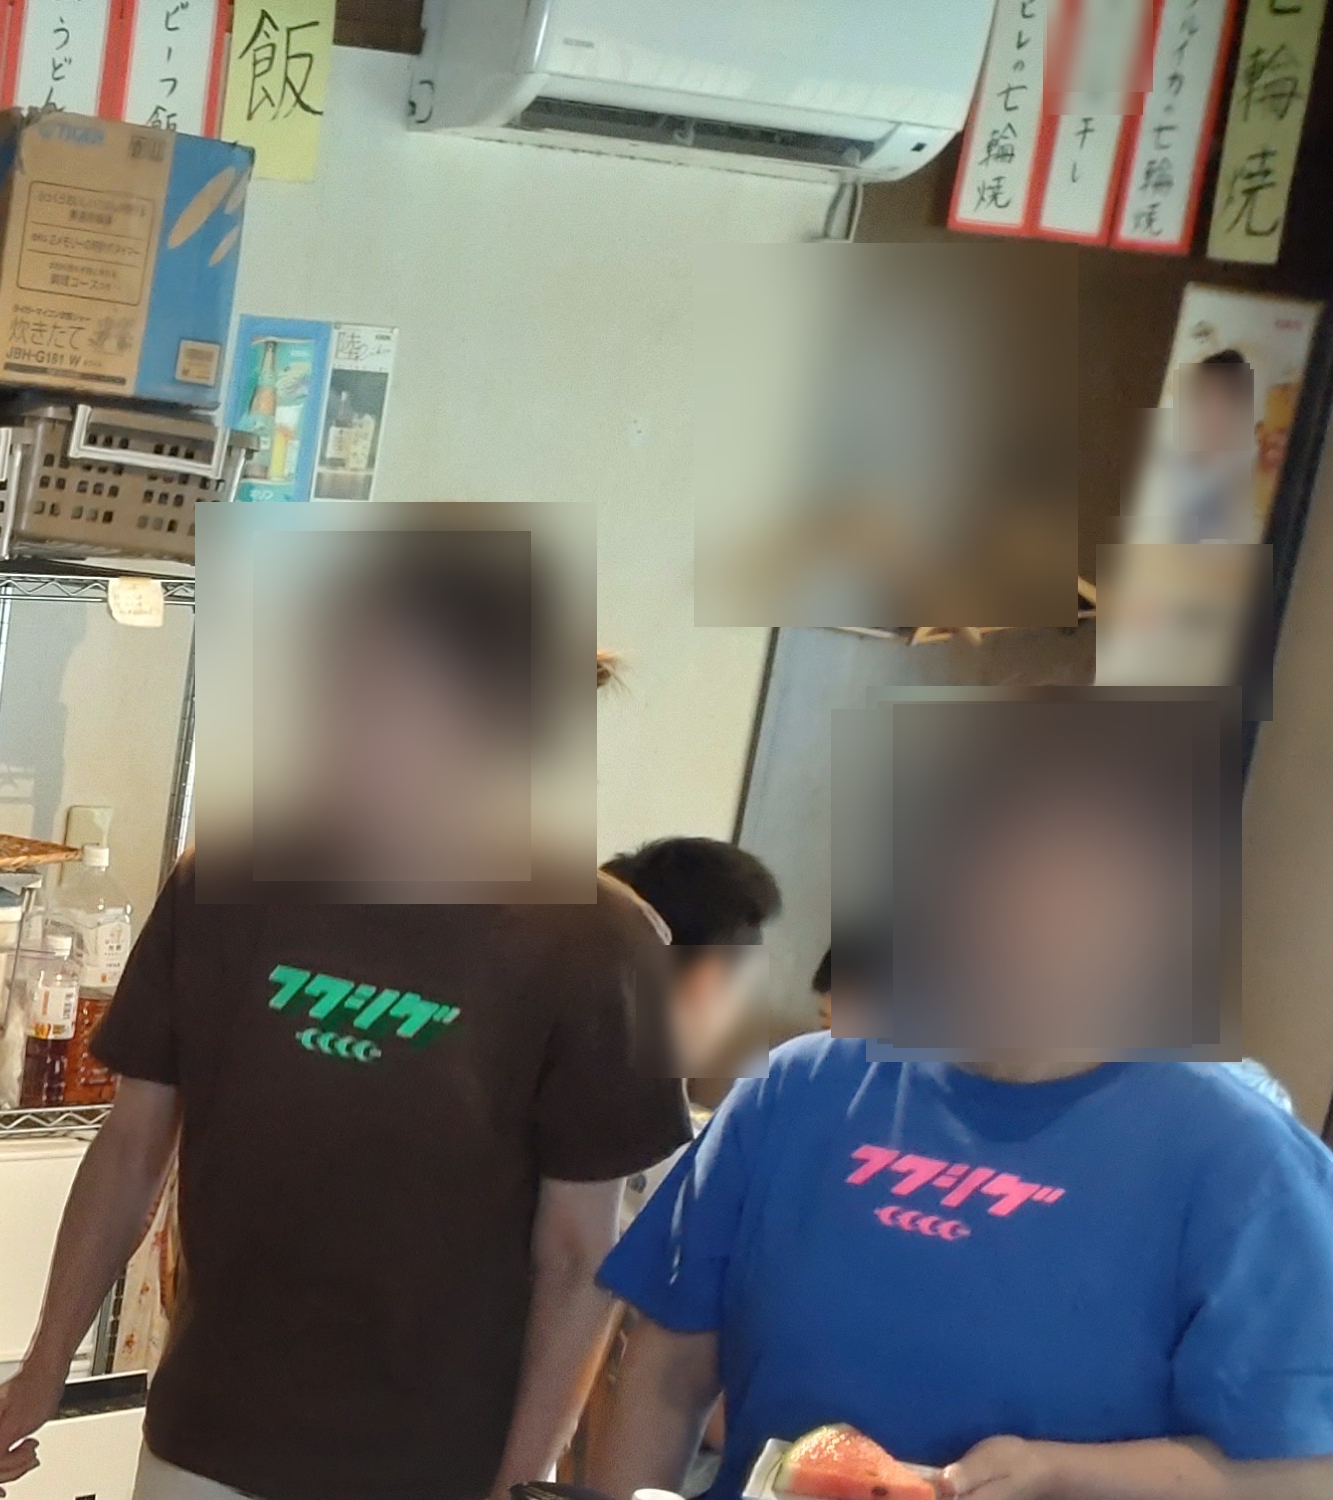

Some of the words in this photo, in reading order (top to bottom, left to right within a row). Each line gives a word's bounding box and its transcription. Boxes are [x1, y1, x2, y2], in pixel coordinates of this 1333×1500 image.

[238, 9, 324, 122] 飯
[7, 314, 86, 350] 炊きたて
